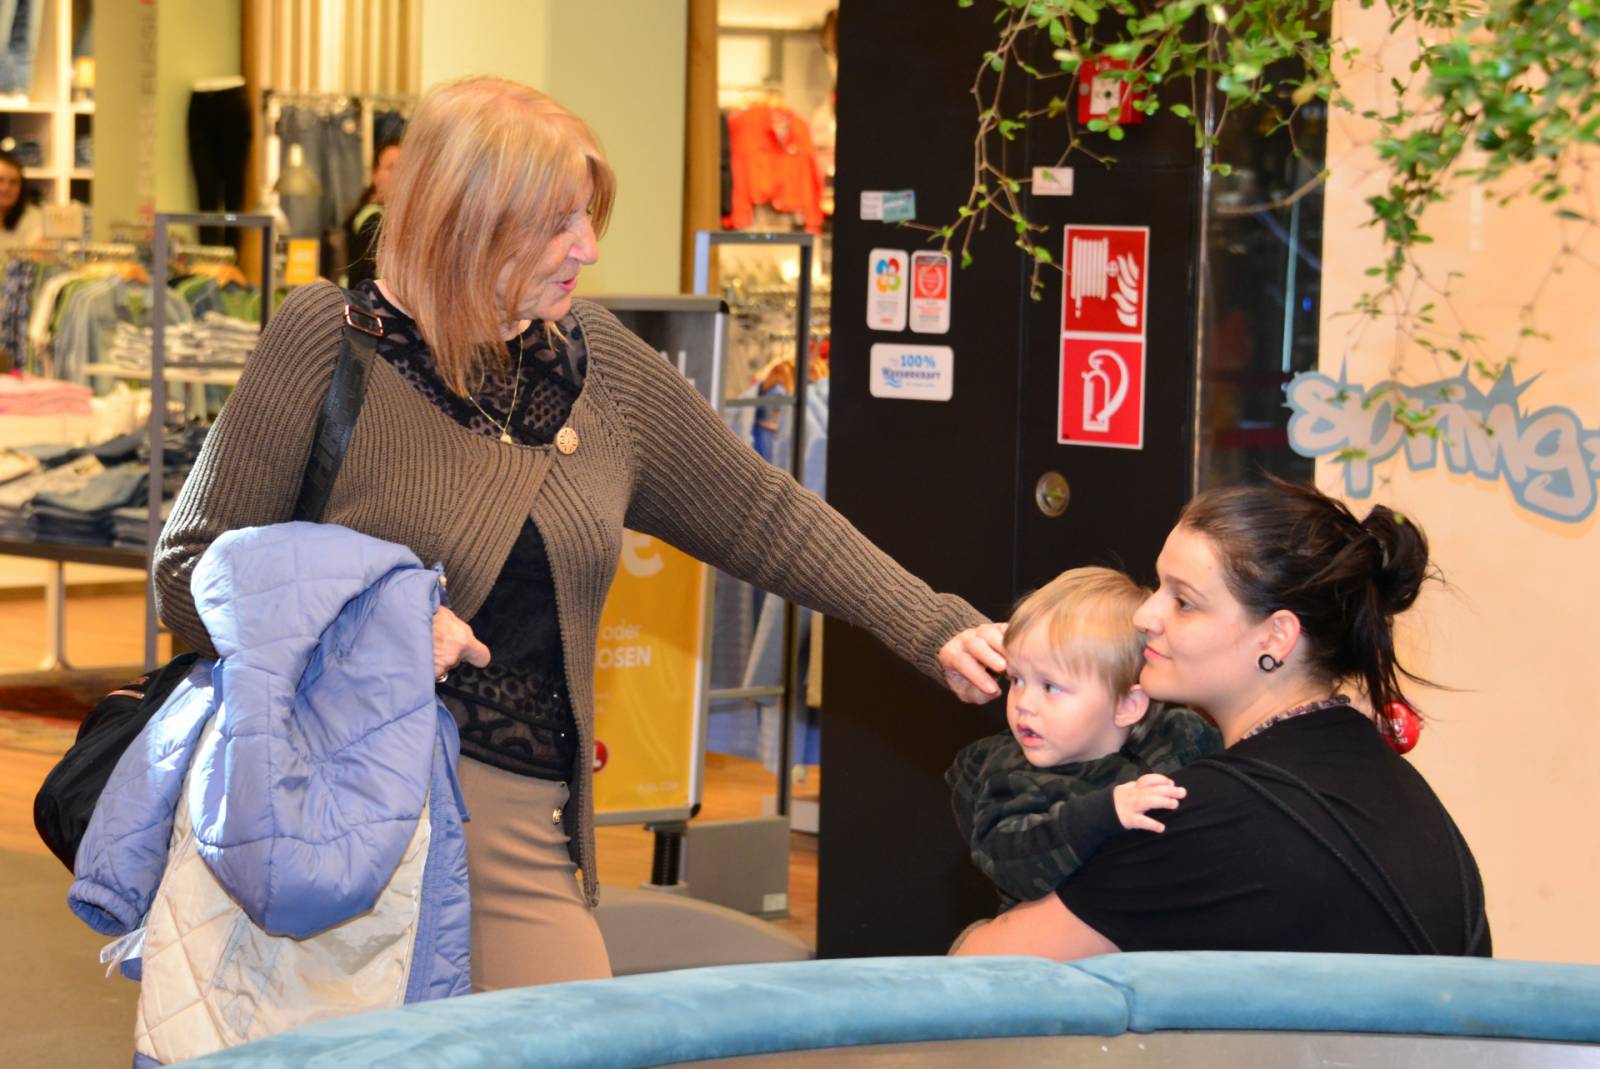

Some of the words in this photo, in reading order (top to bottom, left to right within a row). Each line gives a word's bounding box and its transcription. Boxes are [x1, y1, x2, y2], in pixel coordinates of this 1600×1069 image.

[900, 353, 937, 369] 100%
[600, 619, 642, 641] oder
[597, 645, 653, 669] OSEN
